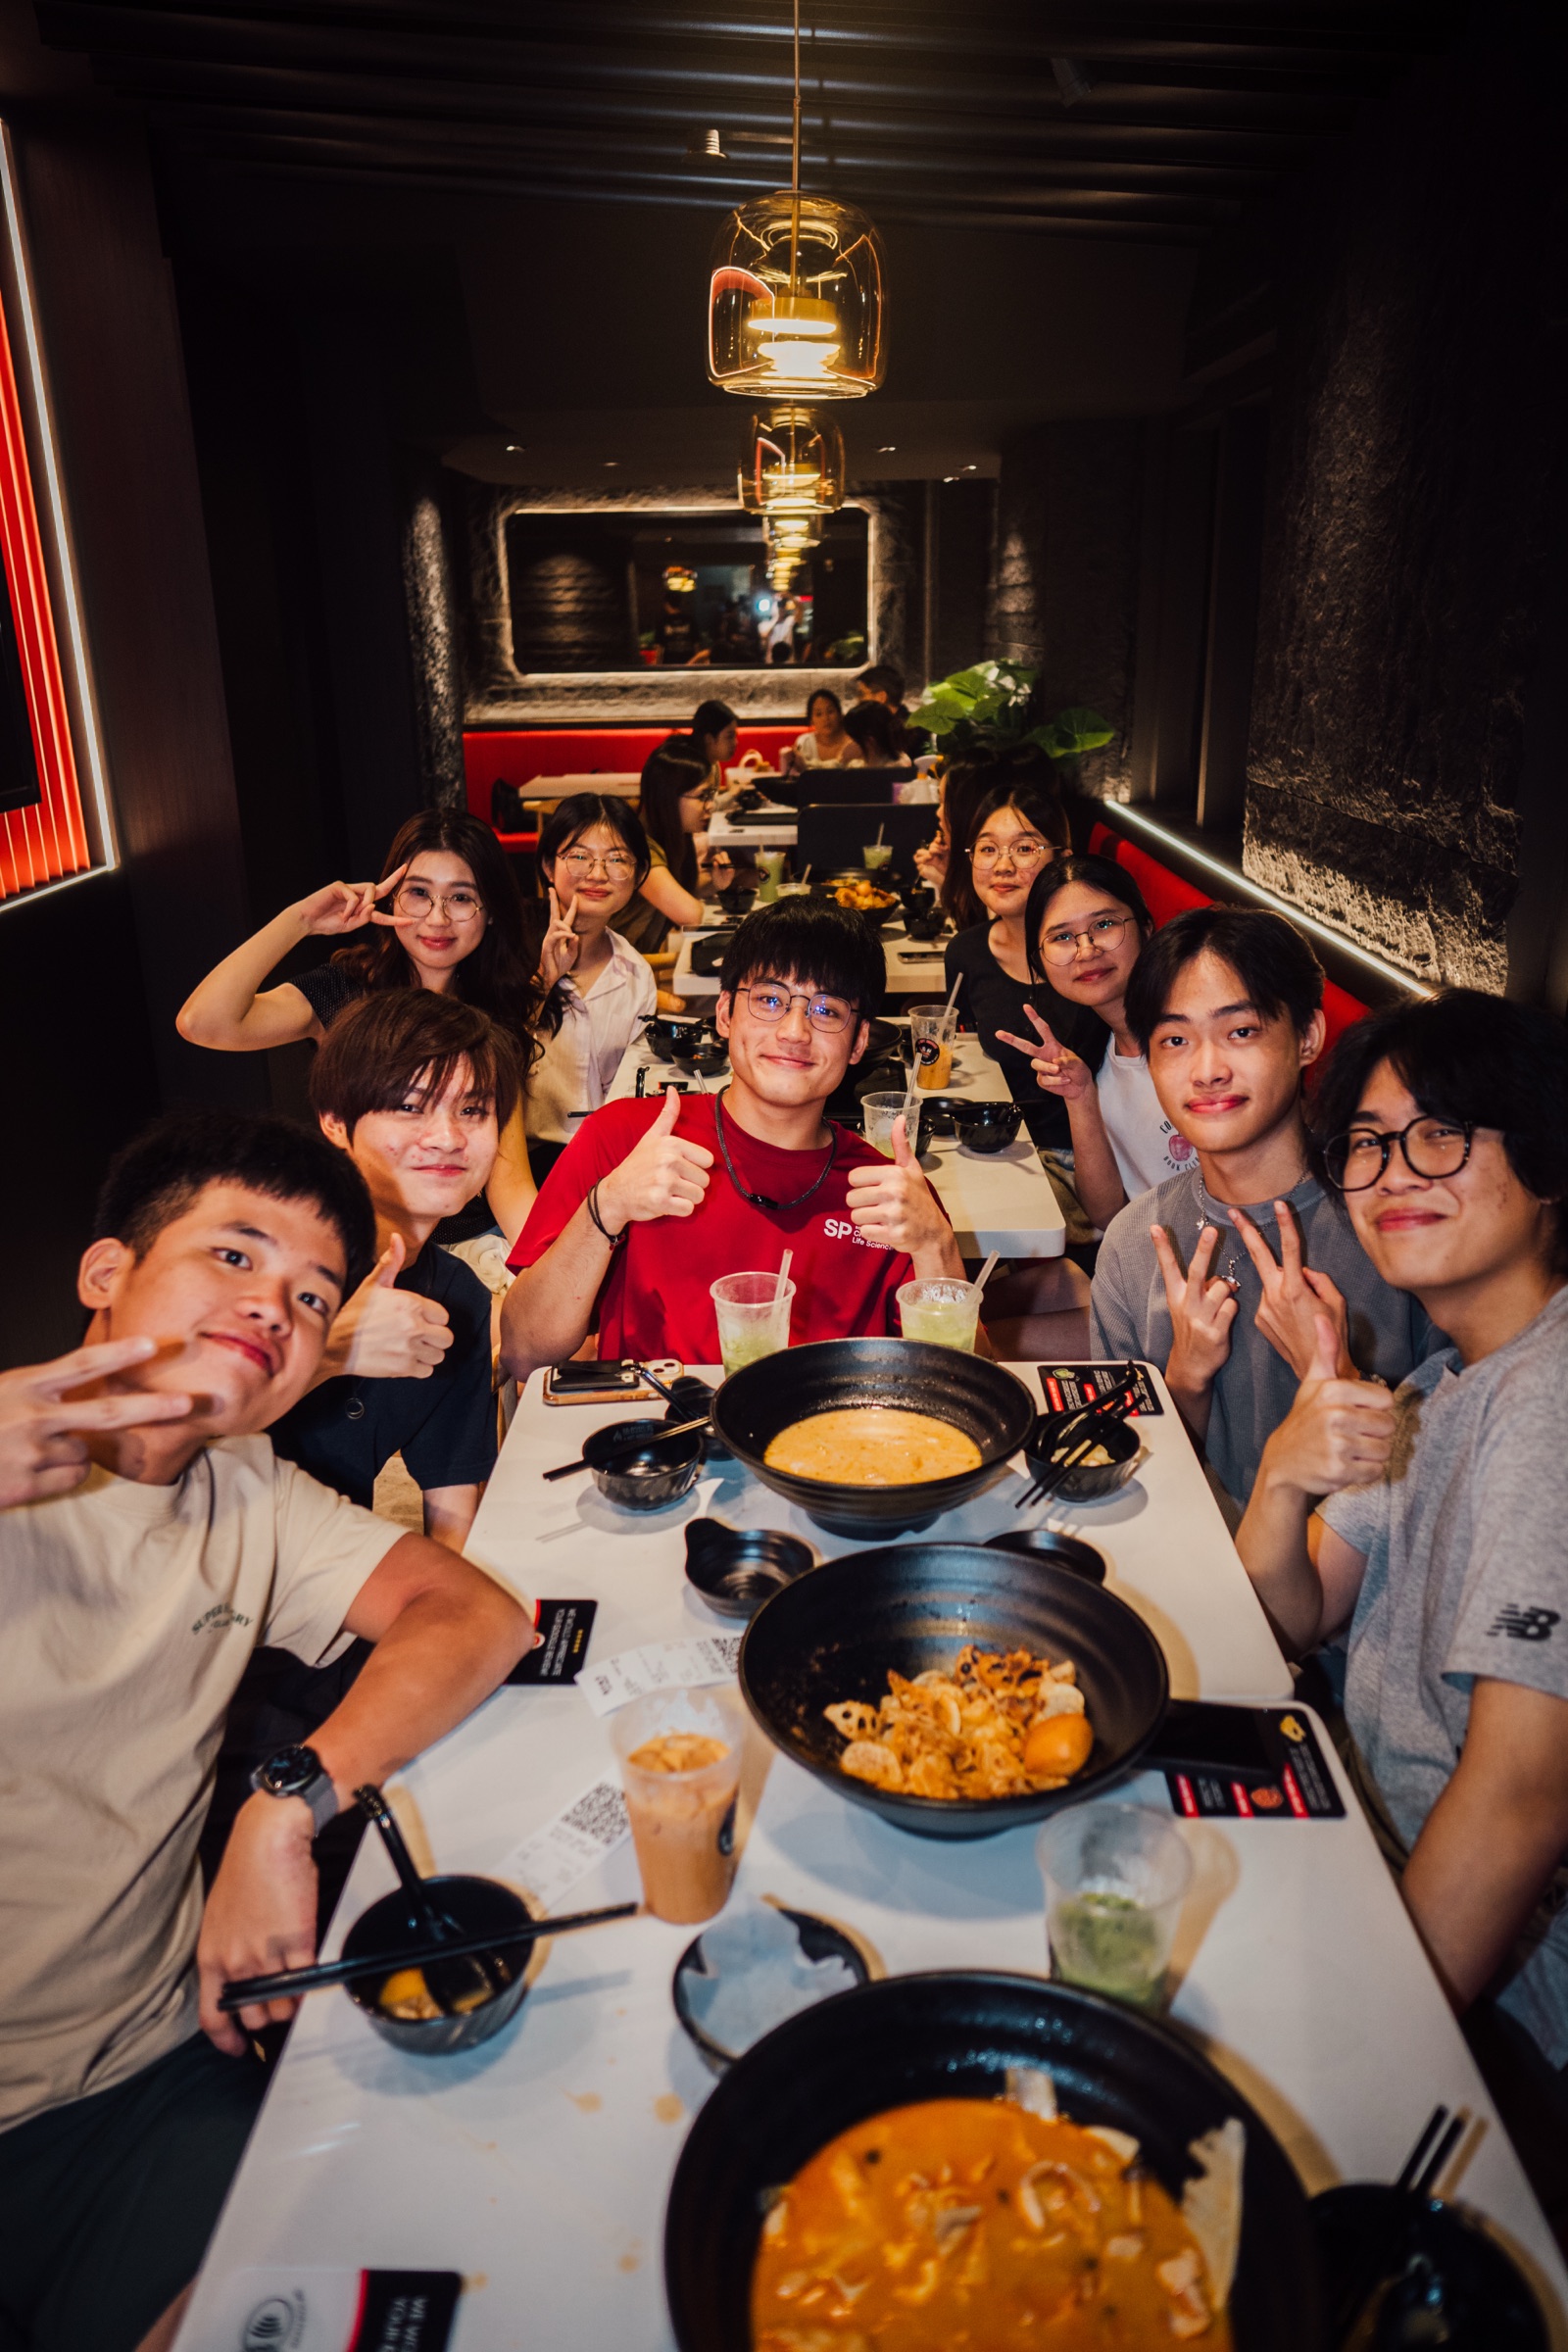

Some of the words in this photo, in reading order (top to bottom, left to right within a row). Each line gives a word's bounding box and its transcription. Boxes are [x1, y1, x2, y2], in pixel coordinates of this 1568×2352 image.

[1159, 1120, 1174, 1134] CO
[824, 1218, 853, 1240] SP
[852, 1237, 865, 1246] Life
